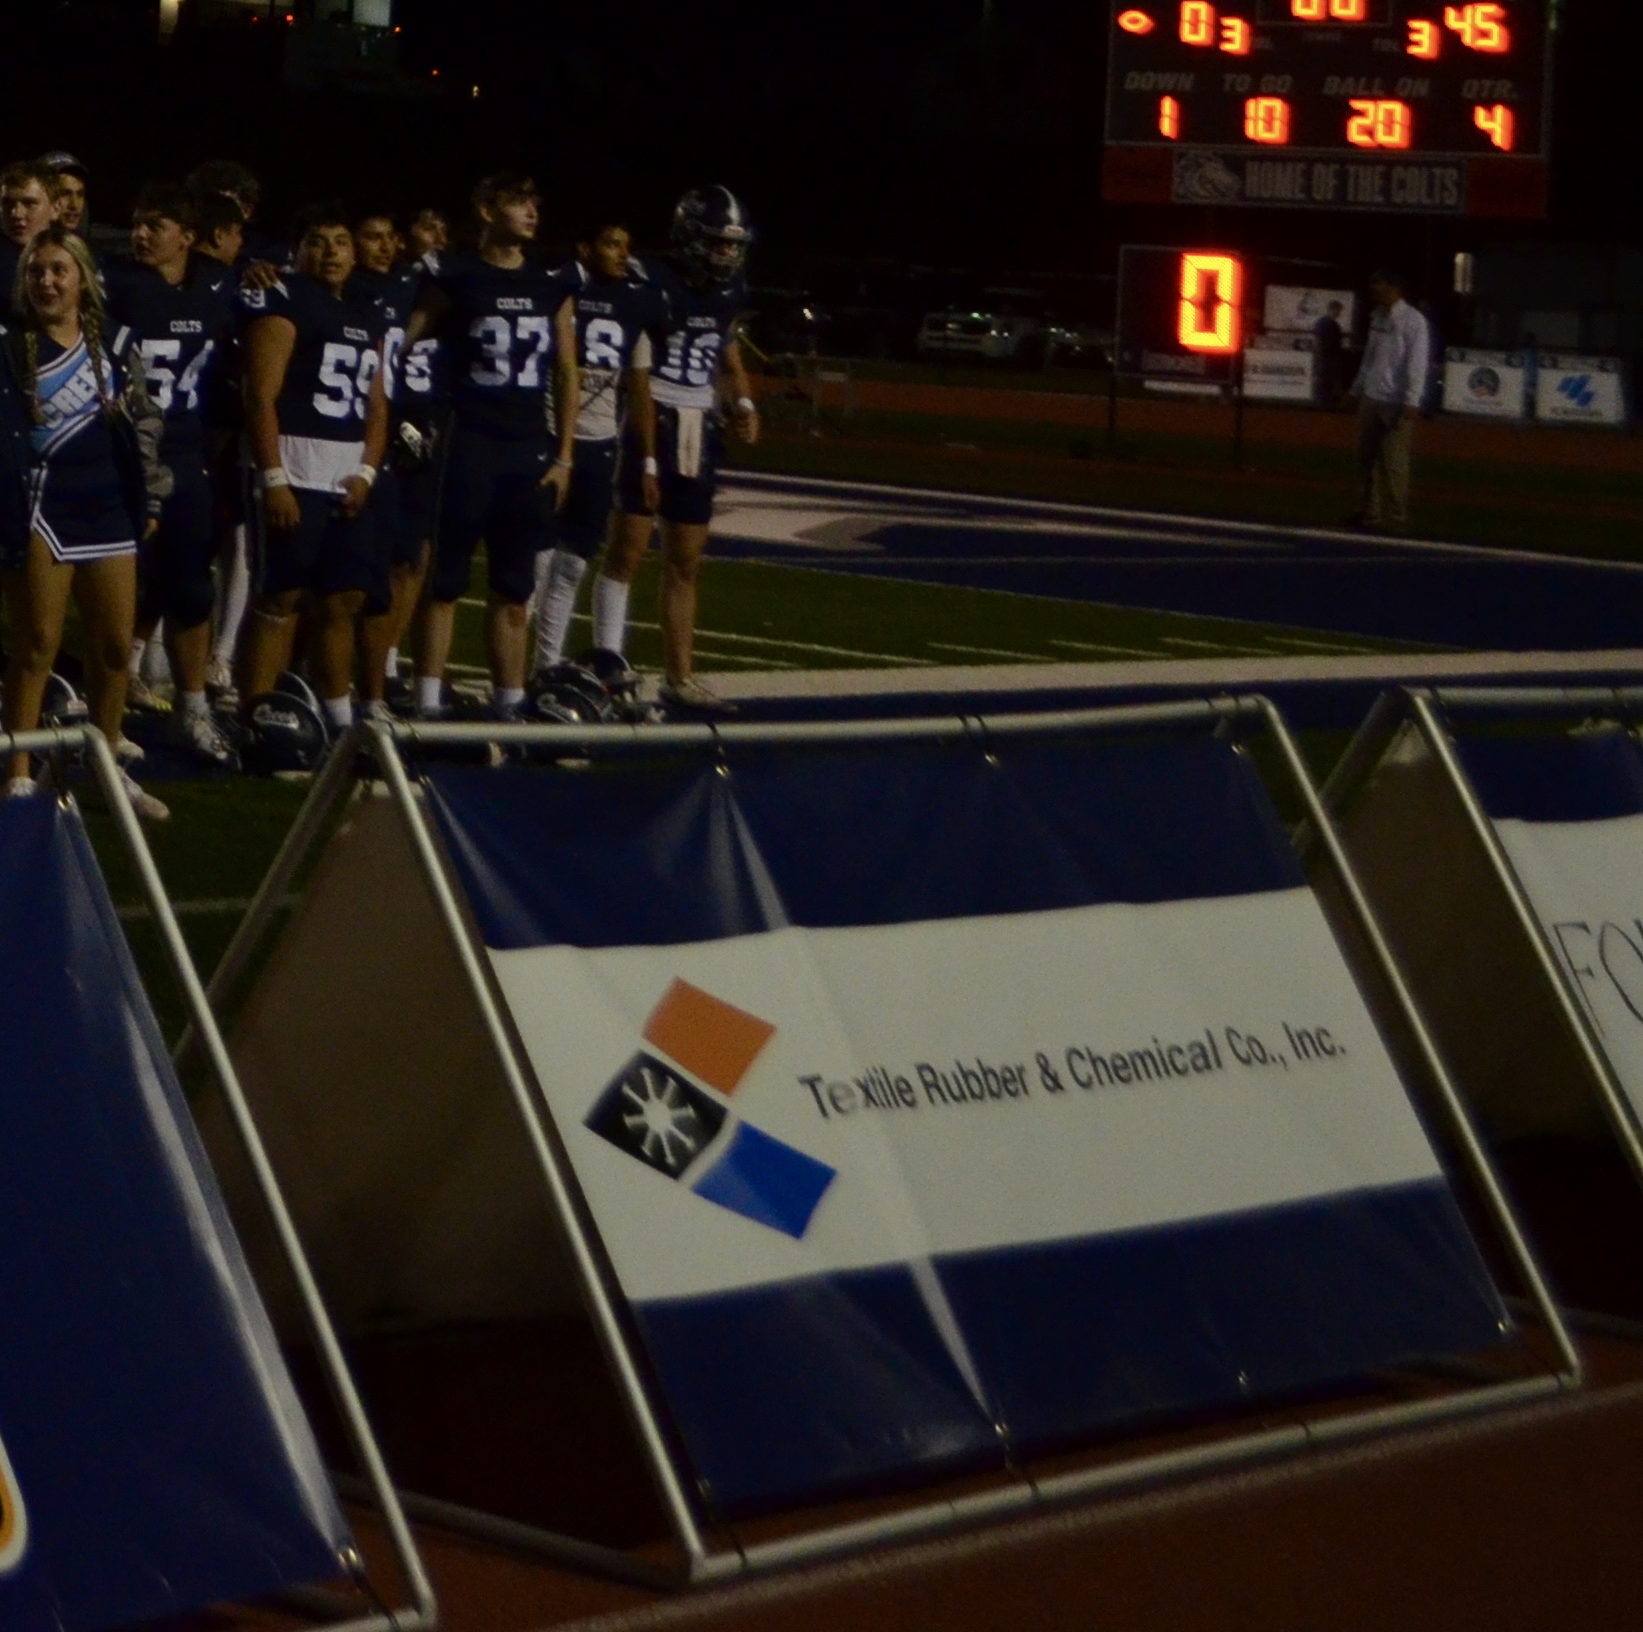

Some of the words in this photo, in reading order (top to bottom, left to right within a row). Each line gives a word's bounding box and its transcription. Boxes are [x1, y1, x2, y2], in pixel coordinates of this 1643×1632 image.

[1443, 2, 1512, 54] 45
[1123, 71, 1195, 92] DOWN
[1222, 73, 1250, 92] TO
[1260, 74, 1293, 93] GO
[1322, 75, 1386, 97] BALL
[1394, 77, 1430, 98] ON
[1158, 94, 1181, 140] 1
[1243, 95, 1292, 145] 10
[1346, 98, 1412, 149] 20
[1472, 103, 1513, 151] 4
[1244, 160, 1306, 200] HOME
[1311, 162, 1340, 202] OF
[1346, 164, 1386, 204] THE
[1391, 165, 1459, 206] COLTS
[169, 320, 203, 333] COLTS
[496, 297, 532, 311] COLTS
[1178, 253, 1240, 352] 0
[140, 338, 215, 410] 54
[468, 315, 551, 388] 37
[798, 1064, 917, 1119] Textile
[915, 1057, 1031, 1106] Rubber
[1035, 1051, 1066, 1093] &
[1066, 1027, 1223, 1090] Chemical
[1225, 1025, 1288, 1071] Co.,
[1281, 1020, 1347, 1061] Inc.
